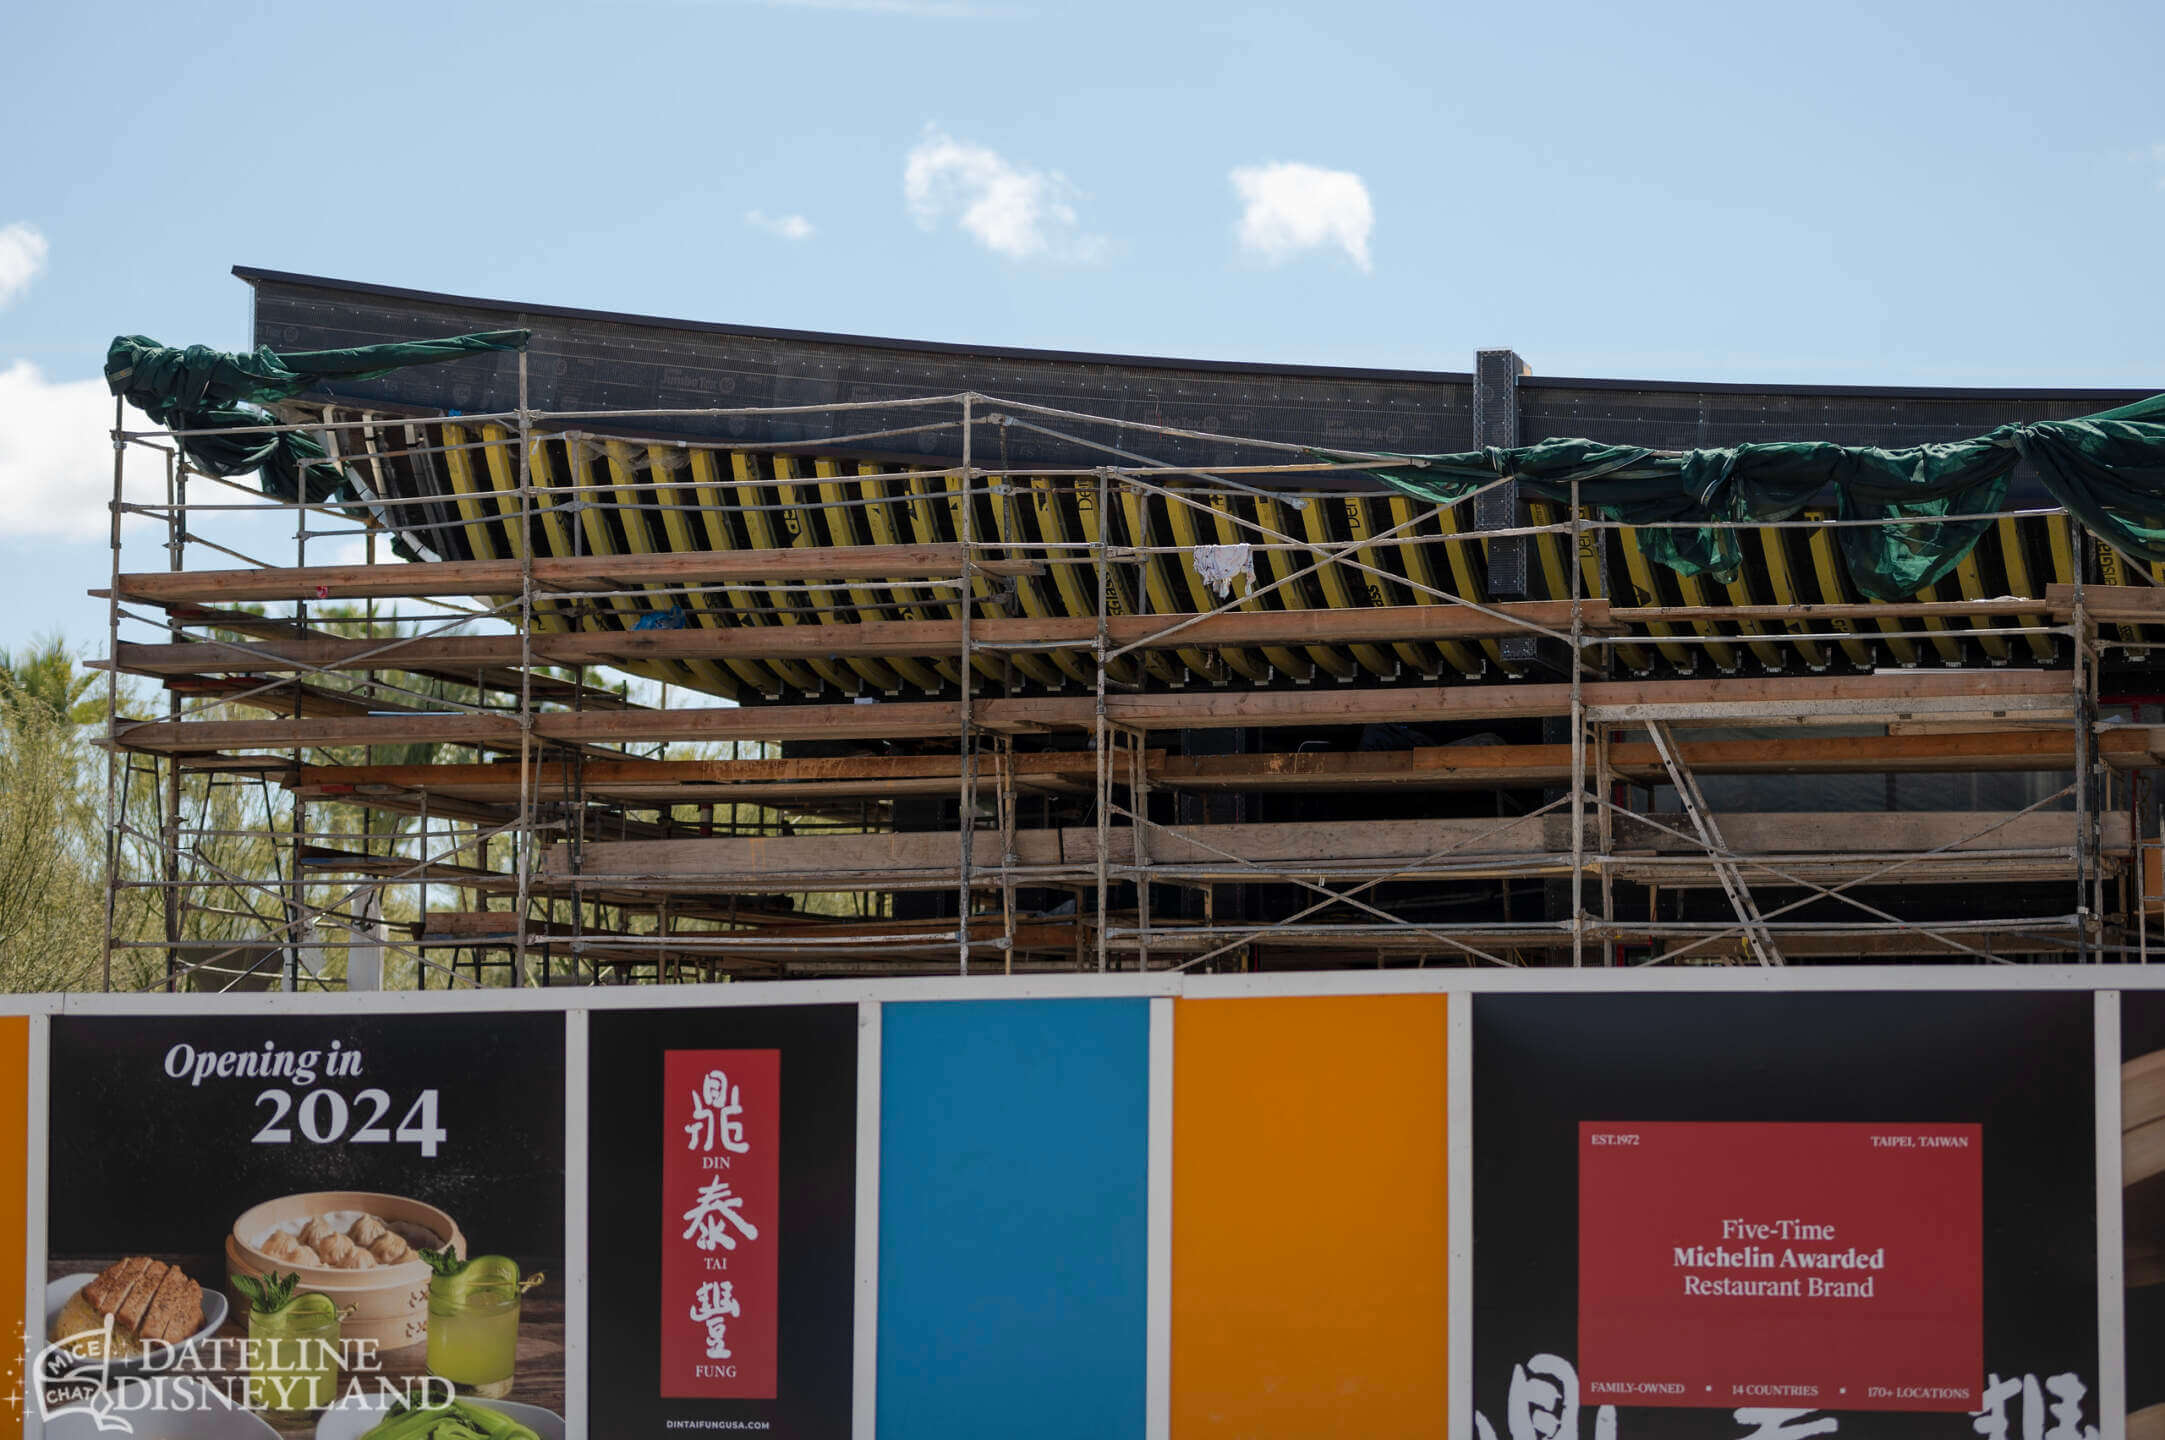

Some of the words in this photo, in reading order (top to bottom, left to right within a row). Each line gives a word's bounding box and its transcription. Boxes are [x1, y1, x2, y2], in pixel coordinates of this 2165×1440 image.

[164, 1040, 319, 1086] Opening
[325, 1039, 364, 1078] in
[250, 1088, 447, 1157] 2024
[1871, 1136, 1916, 1149] TAIPEI,
[1919, 1136, 1969, 1148] TAIWAN
[702, 1156, 730, 1169] DIN
[682, 1174, 759, 1251] 泰
[1722, 1218, 1835, 1241] Five-Time
[703, 1257, 728, 1270] TAI
[1673, 1245, 1775, 1268] Michelin
[1779, 1247, 1885, 1270] Awarded
[1684, 1275, 1801, 1297] Restaurant
[1807, 1276, 1874, 1298] Brand
[695, 1365, 737, 1378] FUNG
[1590, 1381, 1686, 1394] FAMILY-OWNED
[1732, 1384, 1744, 1395] 14
[1746, 1384, 1819, 1396] COUNTRIES
[1868, 1386, 1894, 1397] 170+
[1896, 1387, 1970, 1399] LOCATIONS
[666, 1420, 770, 1430] DINTAIFUNGUSA.COM
